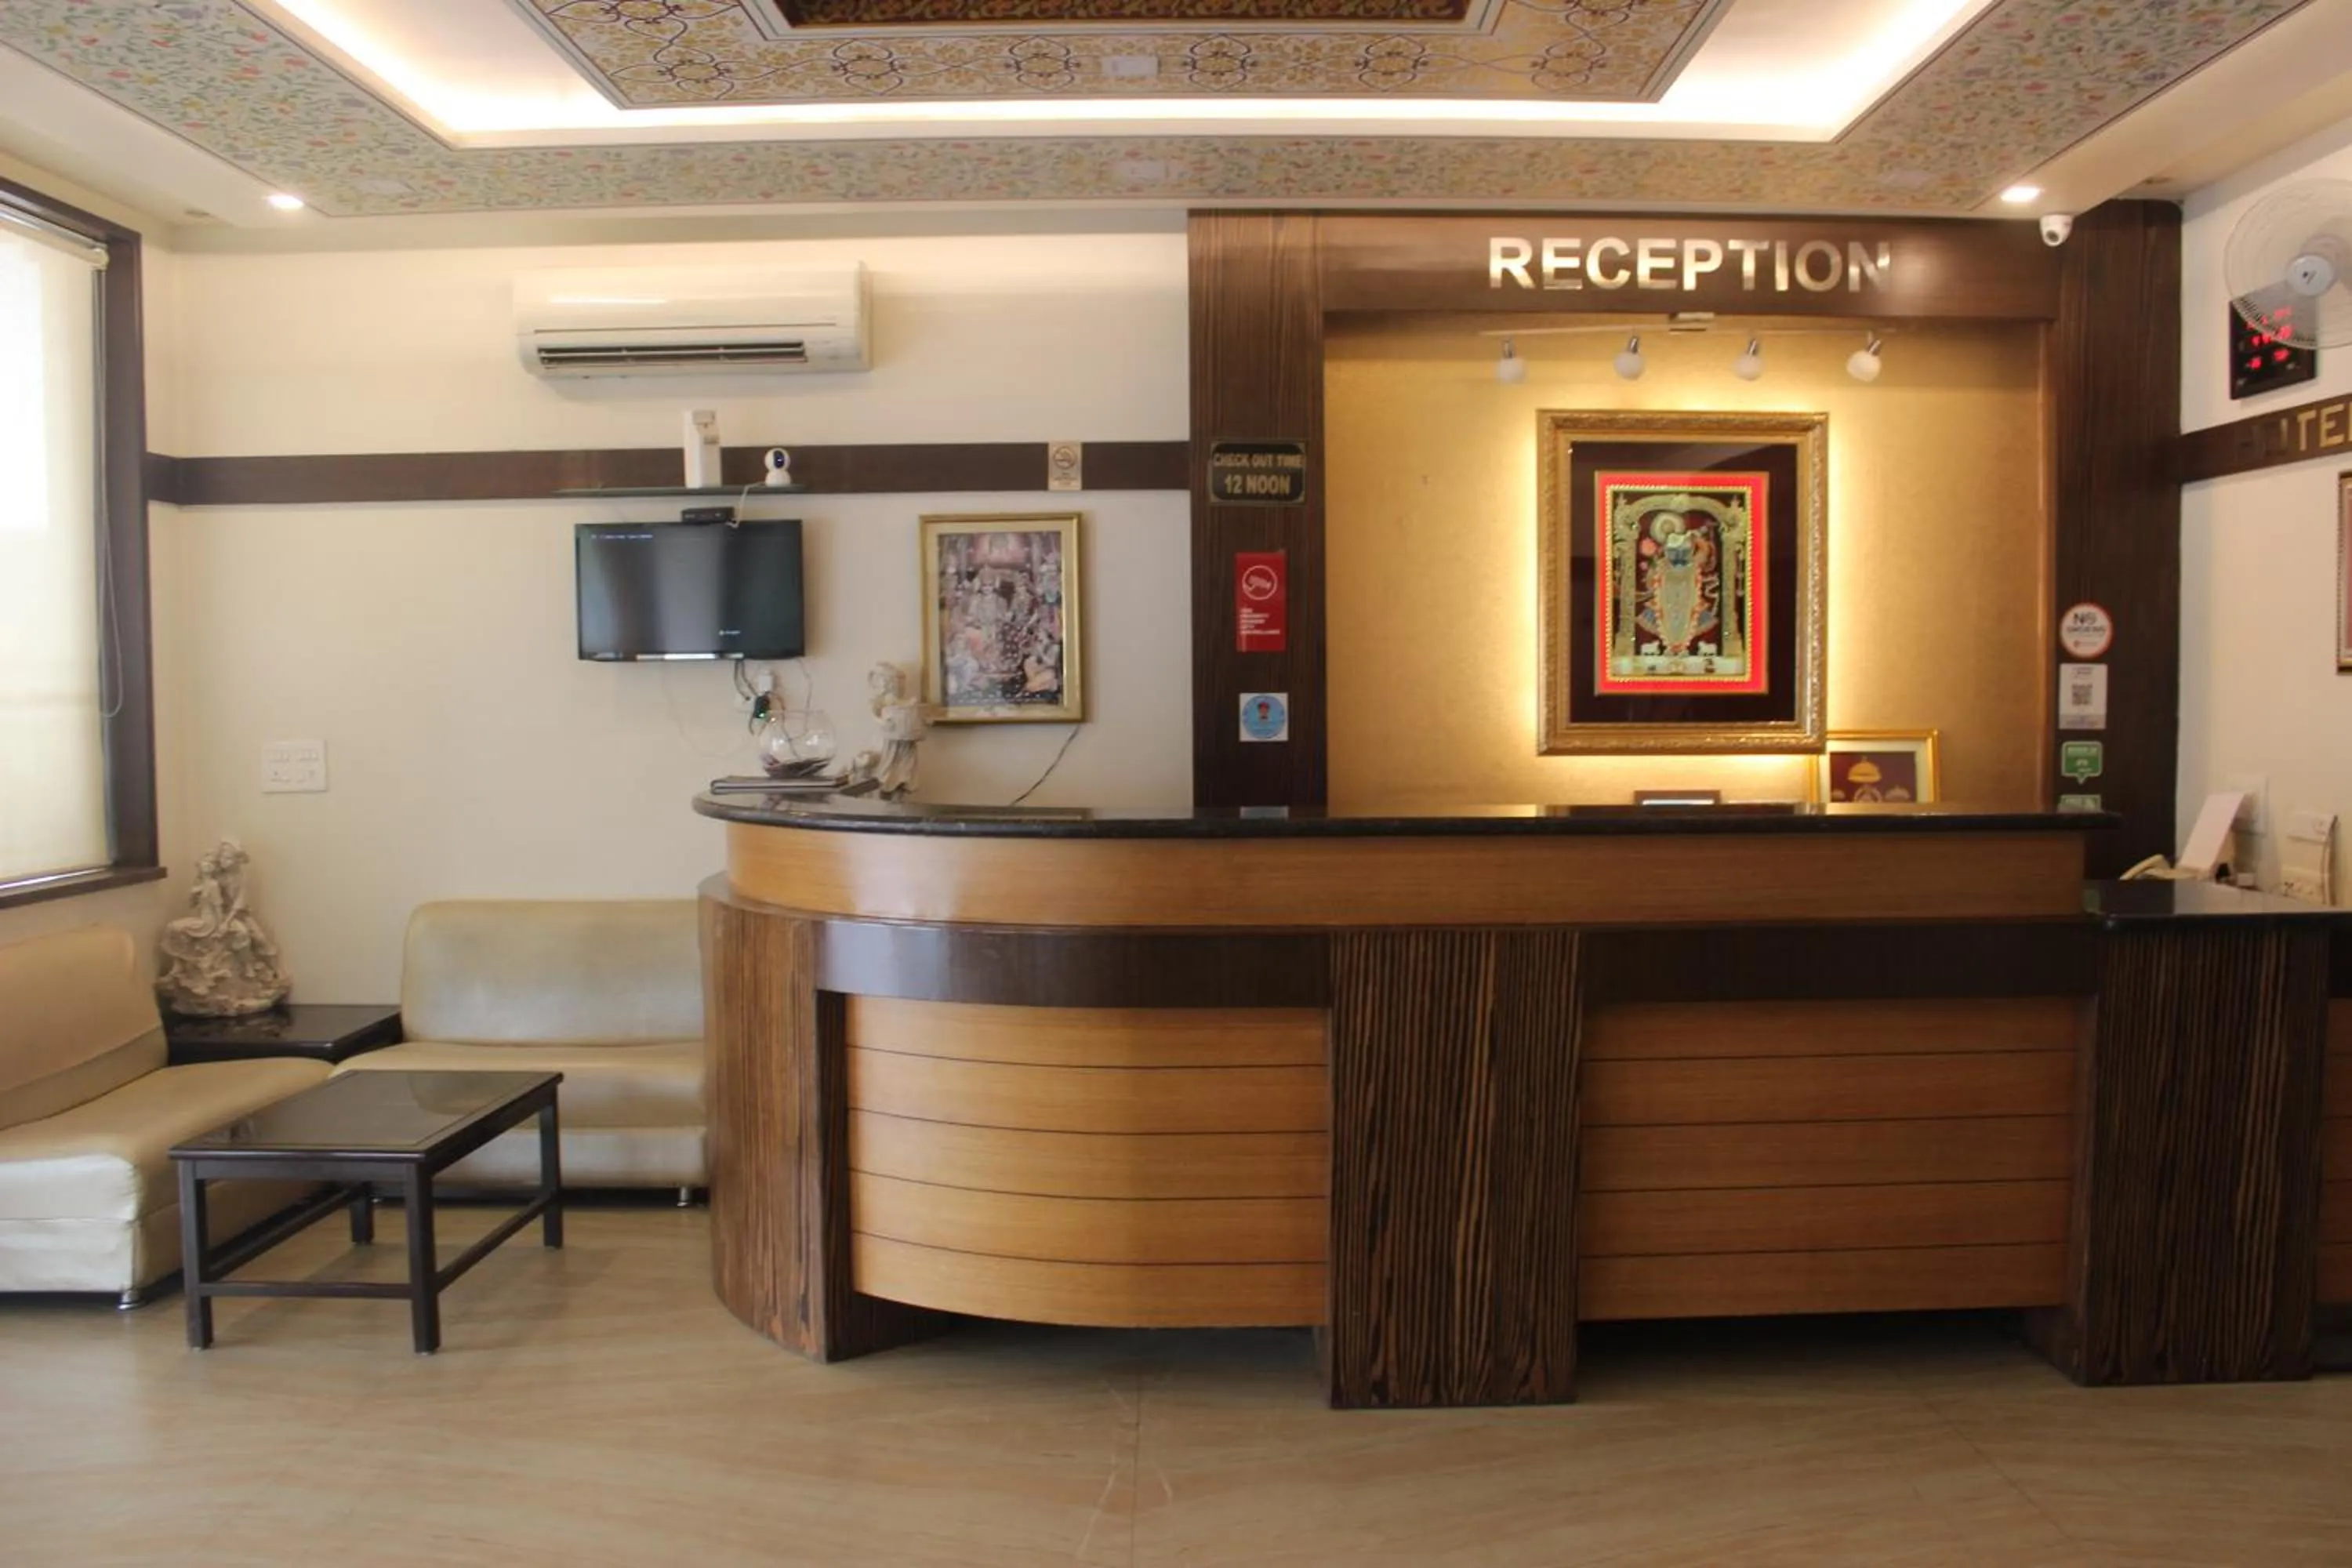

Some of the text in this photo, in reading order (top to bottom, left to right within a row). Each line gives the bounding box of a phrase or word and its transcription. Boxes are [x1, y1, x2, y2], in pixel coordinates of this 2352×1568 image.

[1489, 237, 1890, 291] RECEPTION
[1213, 452, 1250, 467] CHECK
[1251, 453, 1274, 468] OUT
[1225, 474, 1291, 495] 12 NOON
